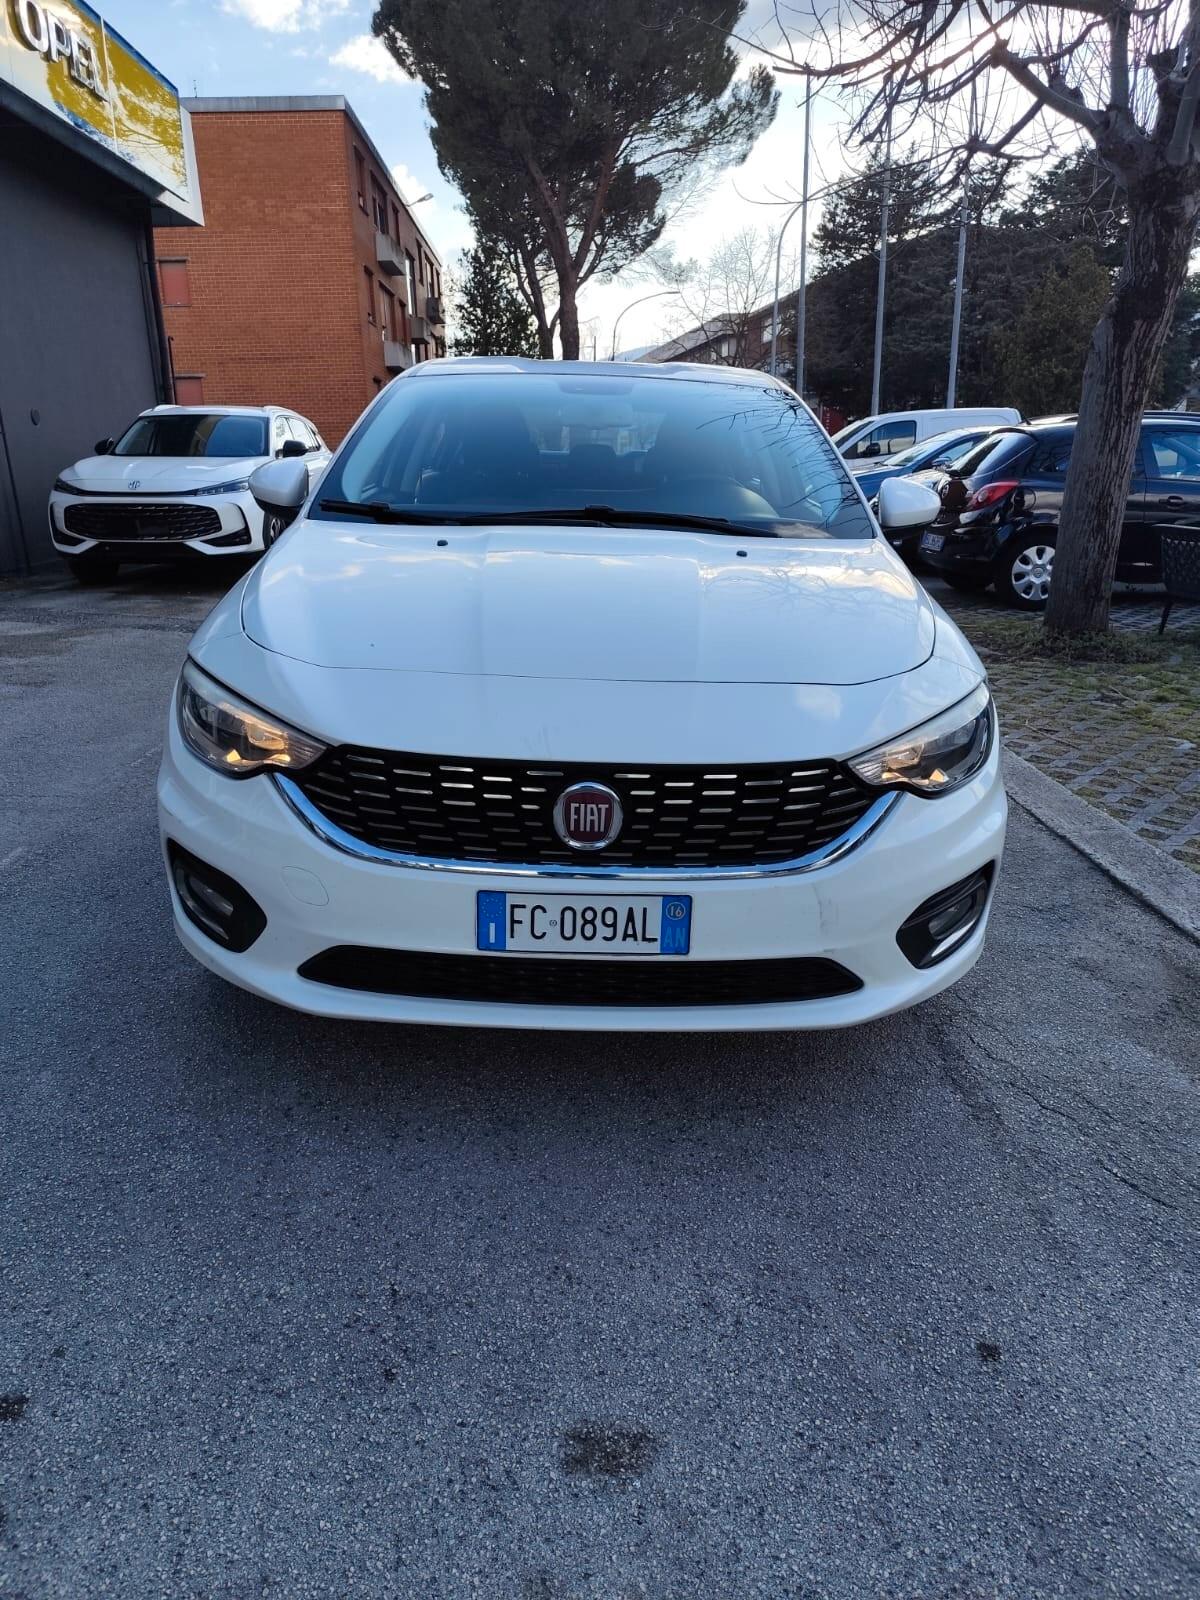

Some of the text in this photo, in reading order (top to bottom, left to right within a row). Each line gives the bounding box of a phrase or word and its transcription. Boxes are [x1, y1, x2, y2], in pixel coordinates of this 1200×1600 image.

[14, 0, 110, 102] OPEL
[570, 803, 608, 832] FIAT
[510, 904, 658, 943] FC 089AL
[668, 905, 683, 917] 16
[489, 922, 496, 943] I
[663, 927, 686, 948] AN
